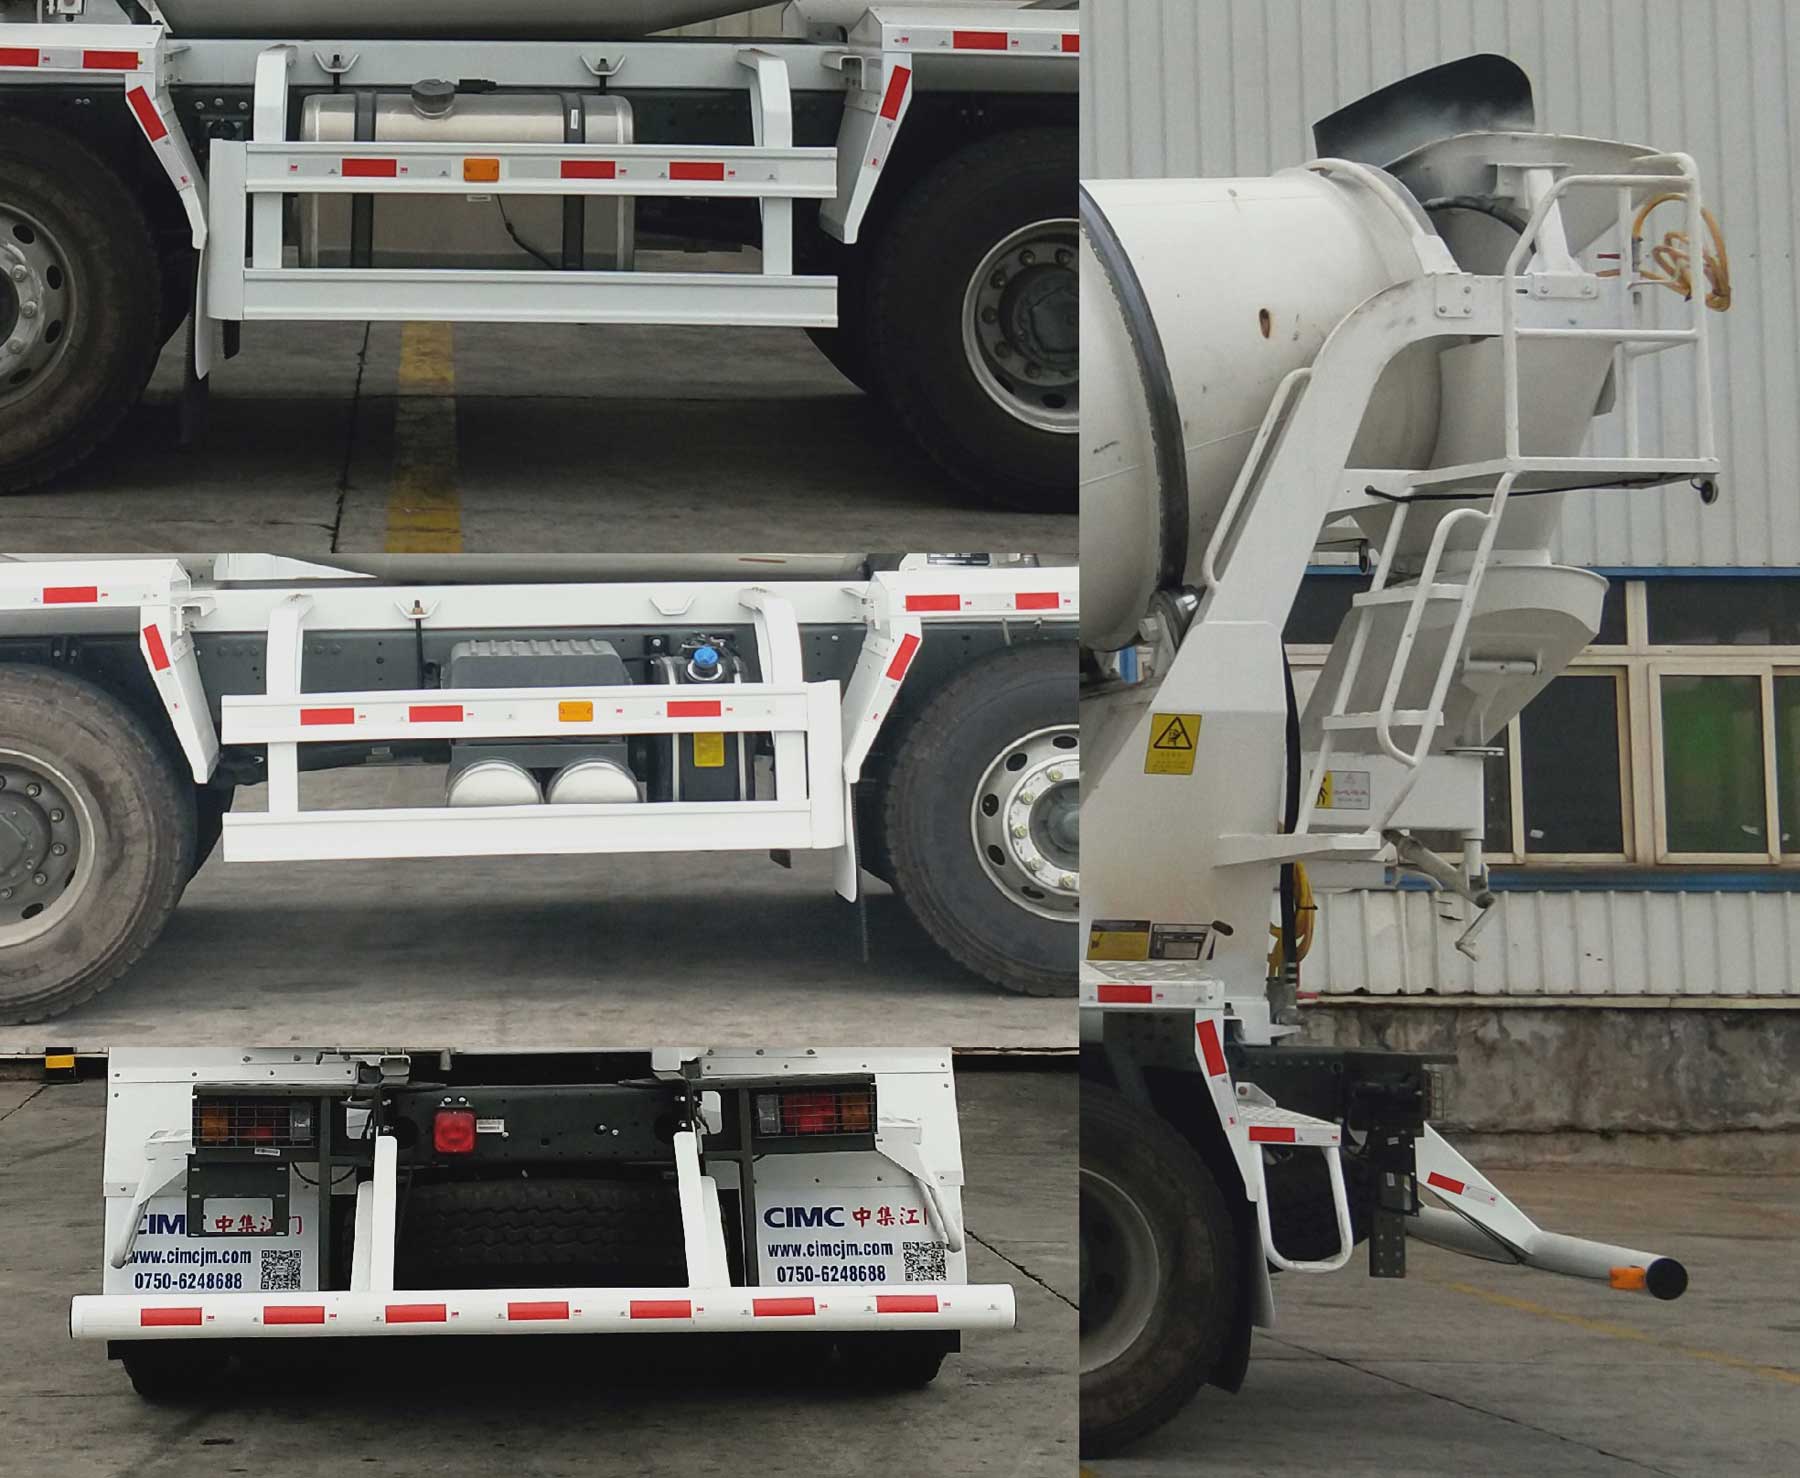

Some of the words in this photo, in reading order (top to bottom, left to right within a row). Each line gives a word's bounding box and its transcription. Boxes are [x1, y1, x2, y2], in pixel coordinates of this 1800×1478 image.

[763, 1206, 845, 1228] CIMC
[852, 1206, 928, 1228] 中集江
[768, 1240, 893, 1260] www.cimcjm.com
[135, 1272, 243, 1290] 0750-6248688
[777, 1265, 886, 1283] 0750-6248688
